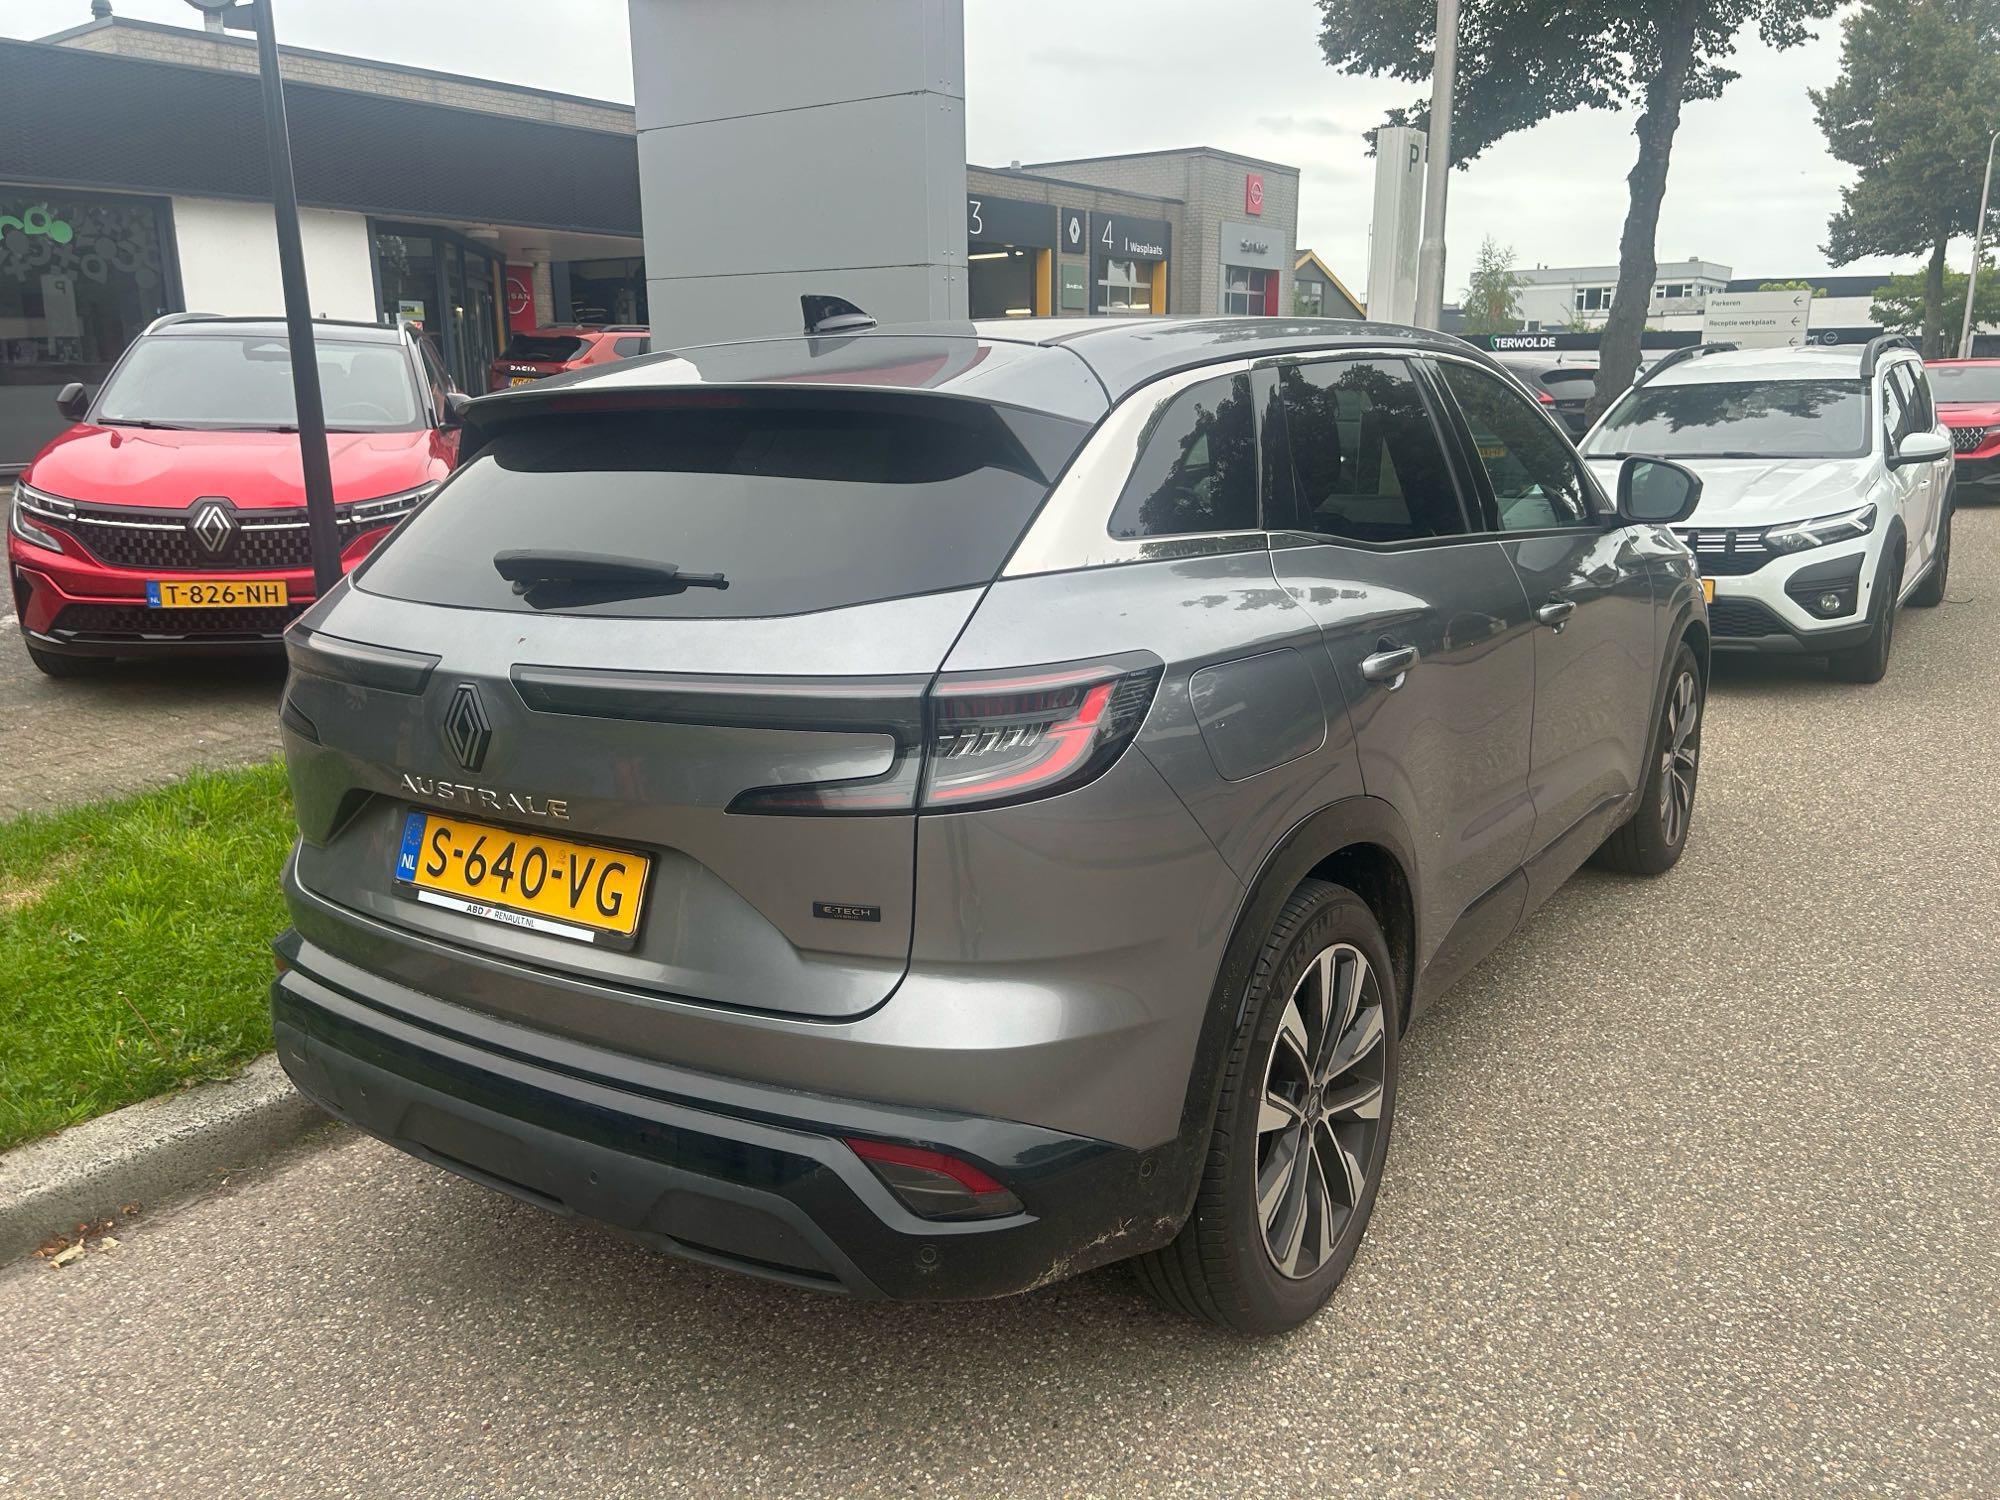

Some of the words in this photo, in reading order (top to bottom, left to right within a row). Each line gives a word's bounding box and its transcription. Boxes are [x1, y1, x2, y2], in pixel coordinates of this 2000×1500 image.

[1409, 143, 1419, 173] P
[969, 200, 983, 235] 3
[1101, 219, 1114, 250] 4
[1129, 241, 1164, 256] Wasplaats
[1495, 337, 1556, 348] TERWOLDE
[510, 364, 537, 372] DACIA
[166, 585, 279, 604] T-826-NH
[400, 773, 569, 820] AUSTRALE
[401, 852, 416, 872] NL
[426, 827, 626, 917] S-640-VG
[466, 905, 485, 916] ABD
[494, 910, 535, 929] RENAULT.NL
[823, 906, 870, 916] E-TECH
